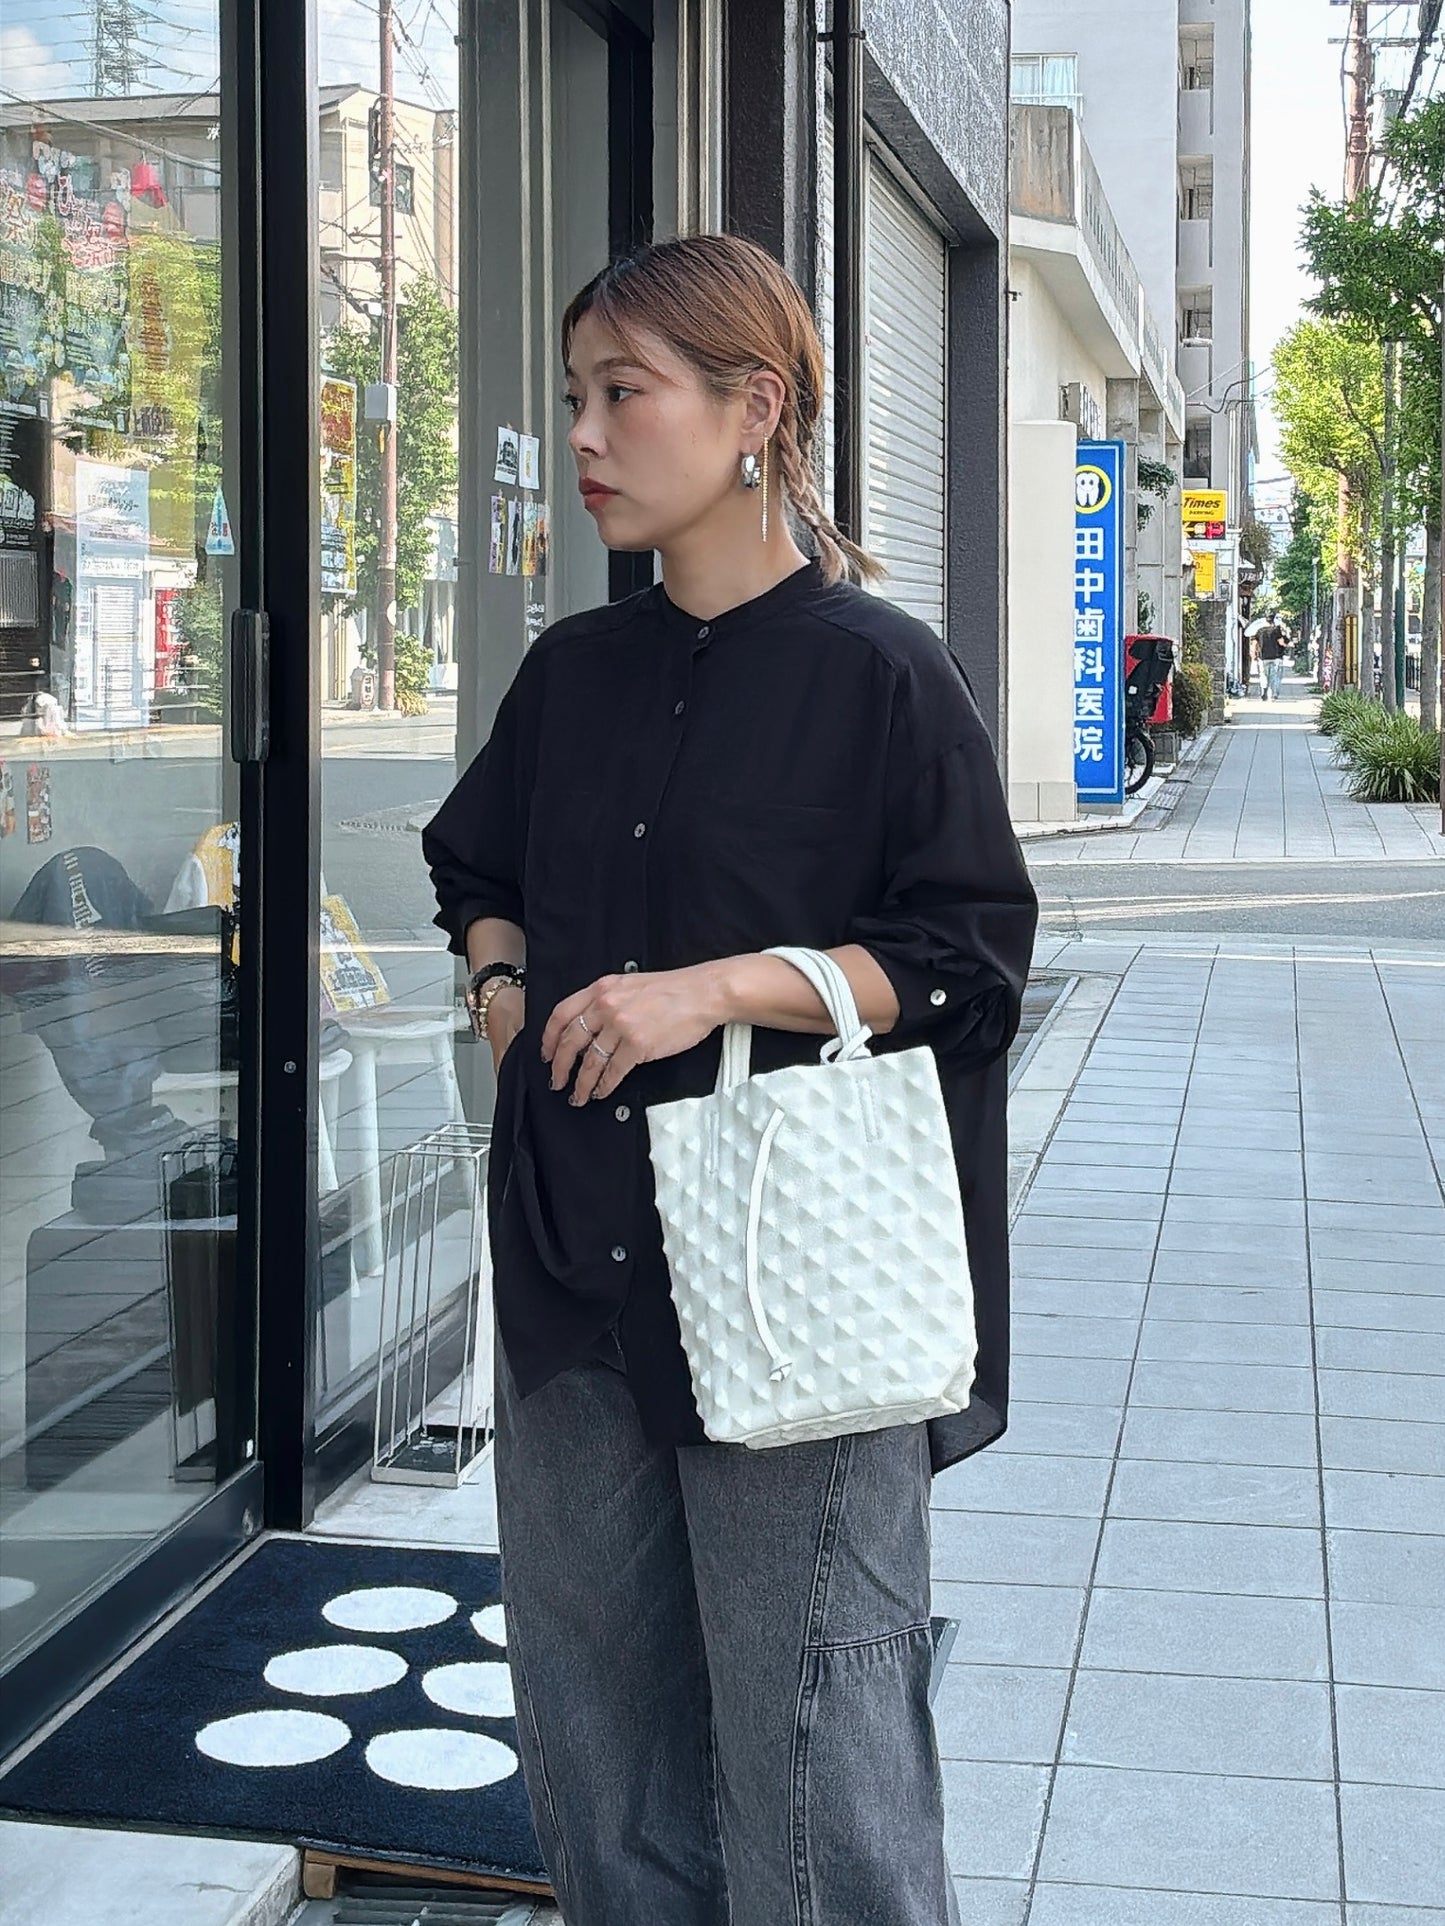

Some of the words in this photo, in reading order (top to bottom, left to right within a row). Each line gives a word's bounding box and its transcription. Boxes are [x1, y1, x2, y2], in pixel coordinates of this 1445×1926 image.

[1183, 497, 1221, 509] Times
[1074, 527, 1105, 761] 田中歯科医院
